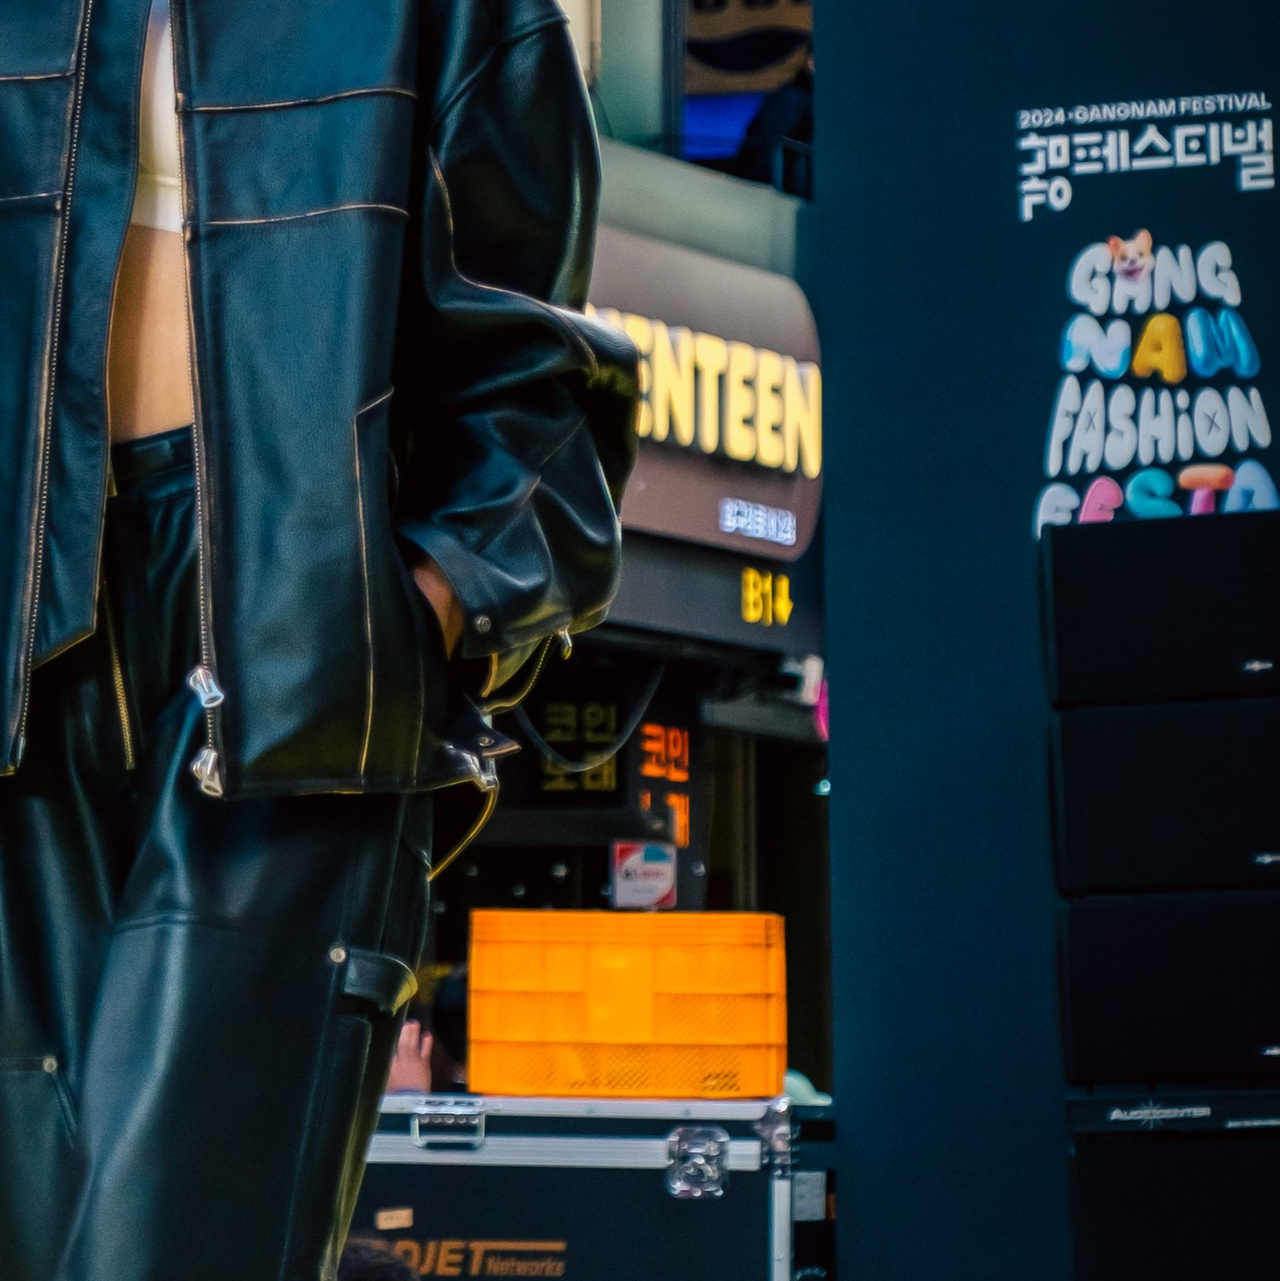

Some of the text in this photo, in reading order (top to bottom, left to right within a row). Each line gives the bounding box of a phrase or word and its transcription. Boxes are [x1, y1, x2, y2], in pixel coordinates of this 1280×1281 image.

[1018, 91, 1272, 129] 2024 GANGNAM FESTIVAL
[1062, 307, 1261, 384] NAM
[588, 304, 822, 480] ENTEEN
[741, 566, 773, 627] B1
